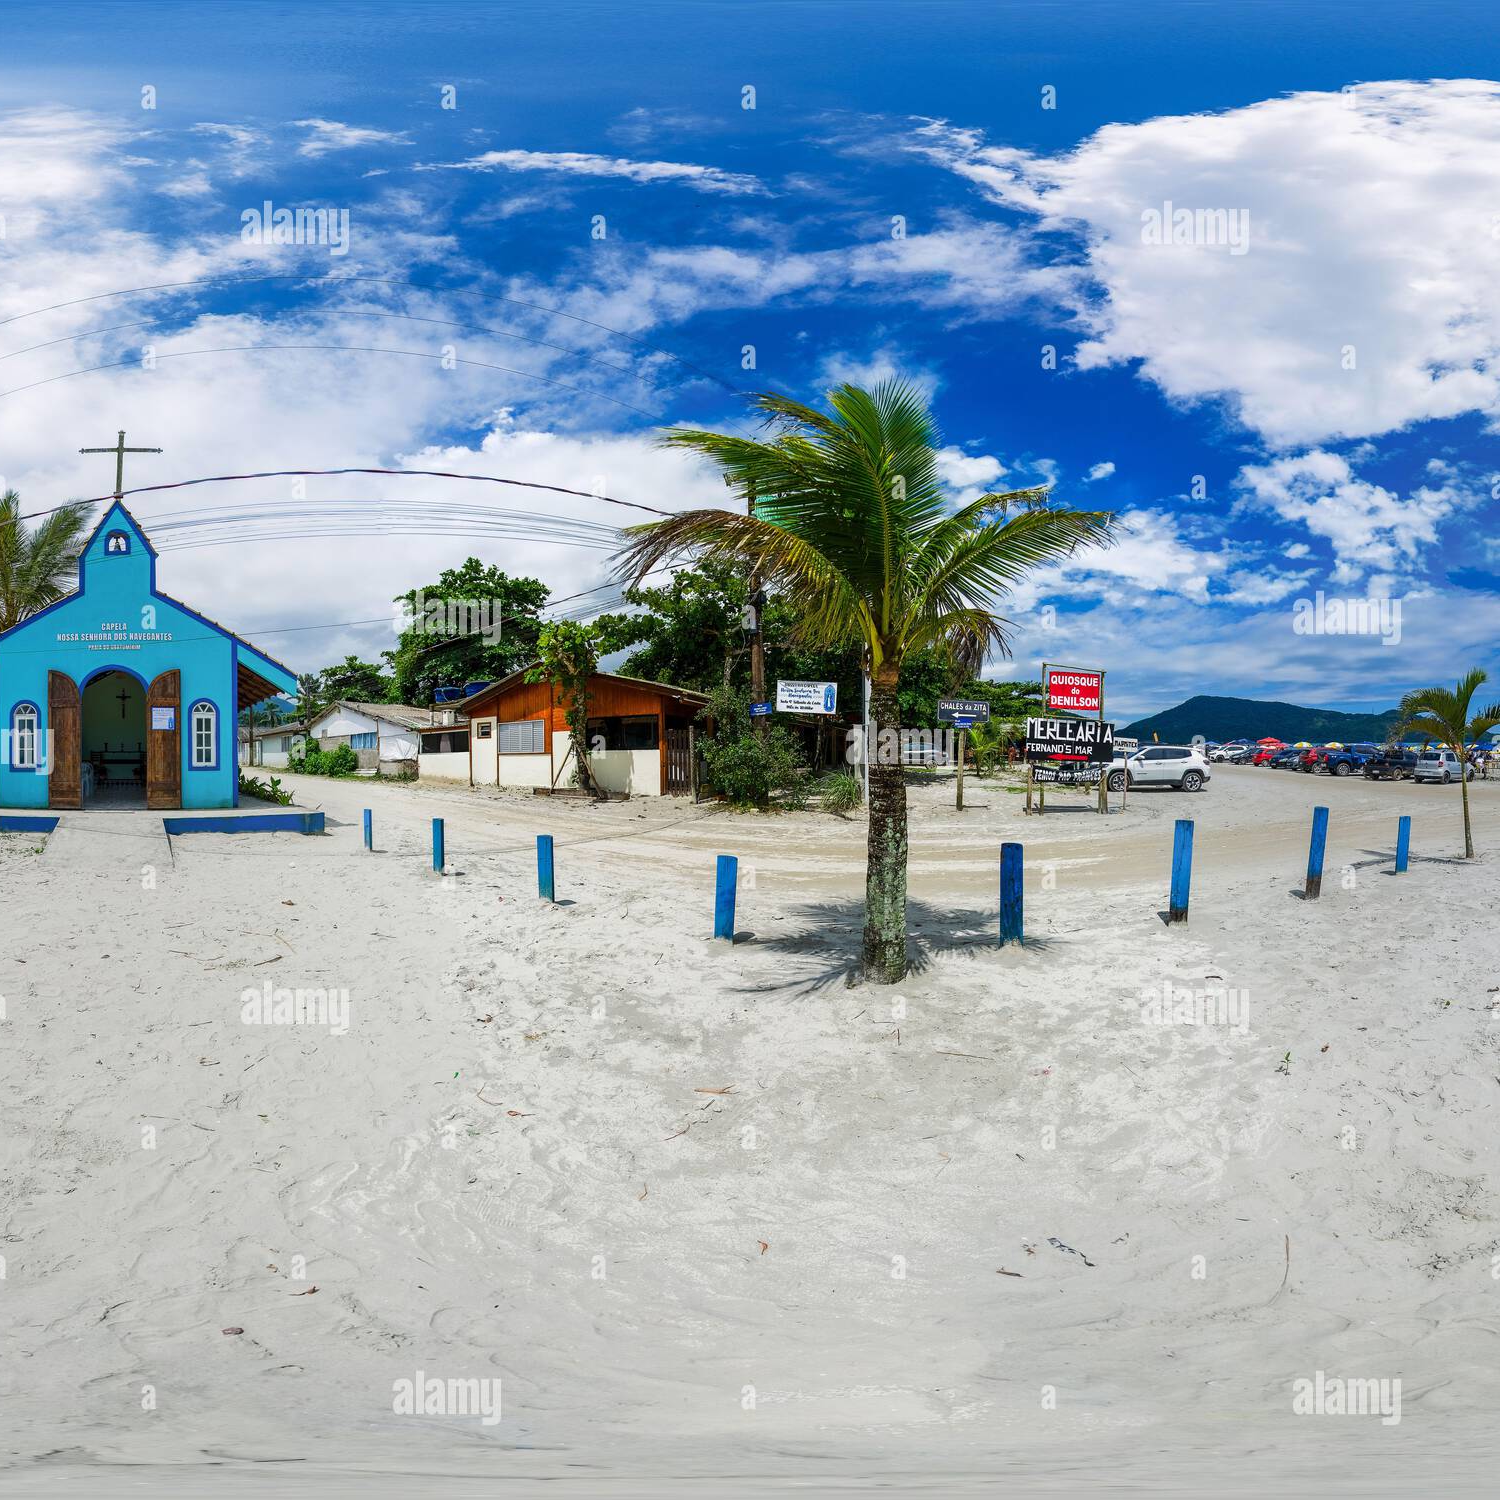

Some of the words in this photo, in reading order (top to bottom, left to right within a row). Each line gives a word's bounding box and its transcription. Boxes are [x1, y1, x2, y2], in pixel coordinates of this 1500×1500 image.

[101, 623, 127, 631] CAPELA
[57, 633, 79, 641] NOSSA
[81, 632, 112, 641] SENHORA
[114, 632, 127, 640] DOS
[129, 632, 173, 641] NAVEGANTES
[1051, 675, 1099, 687] QUIOSQUE
[1071, 687, 1080, 695] do
[1050, 695, 1099, 707] DENILSON
[940, 702, 964, 710] CHALES
[965, 703, 972, 711] da
[973, 703, 987, 711] ZITA
[1075, 745, 1093, 755] MAR
[1034, 769, 1056, 781] TEMOS
